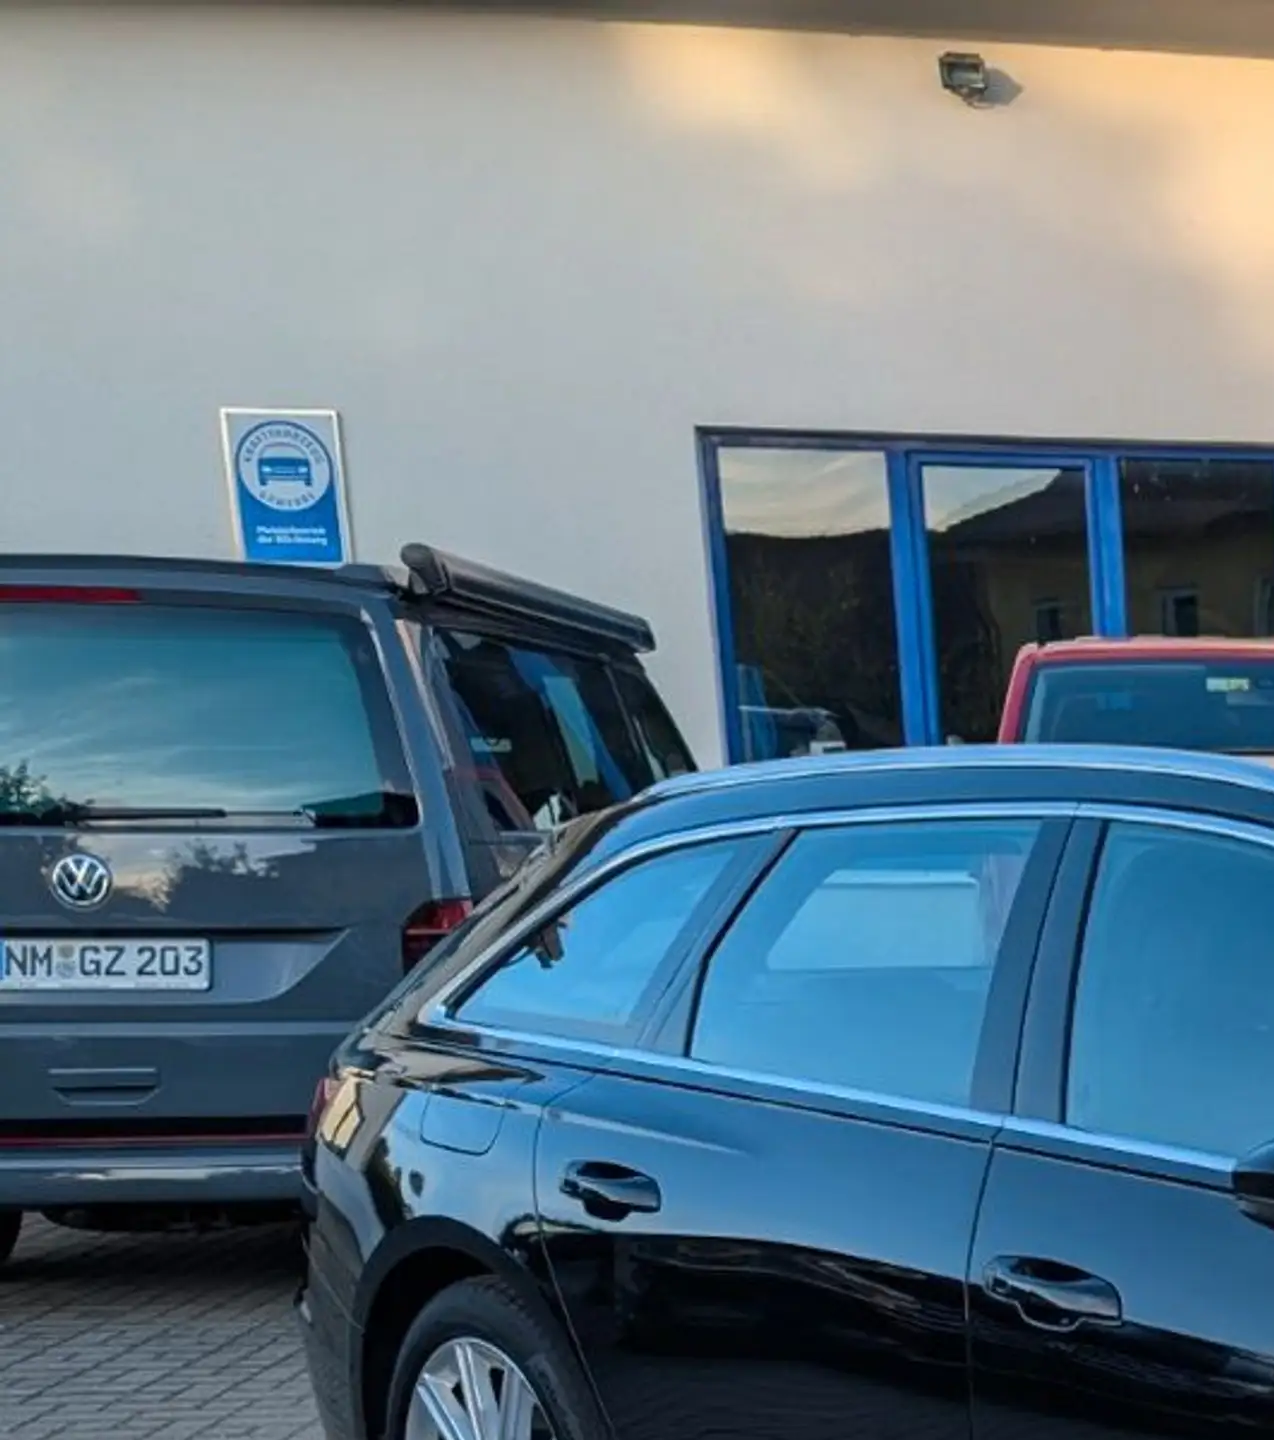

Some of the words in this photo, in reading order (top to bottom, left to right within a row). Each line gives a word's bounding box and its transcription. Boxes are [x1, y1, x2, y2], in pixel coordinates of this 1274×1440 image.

[5, 946, 52, 976] NM
[80, 946, 126, 976] GZ
[136, 946, 203, 976] 203
